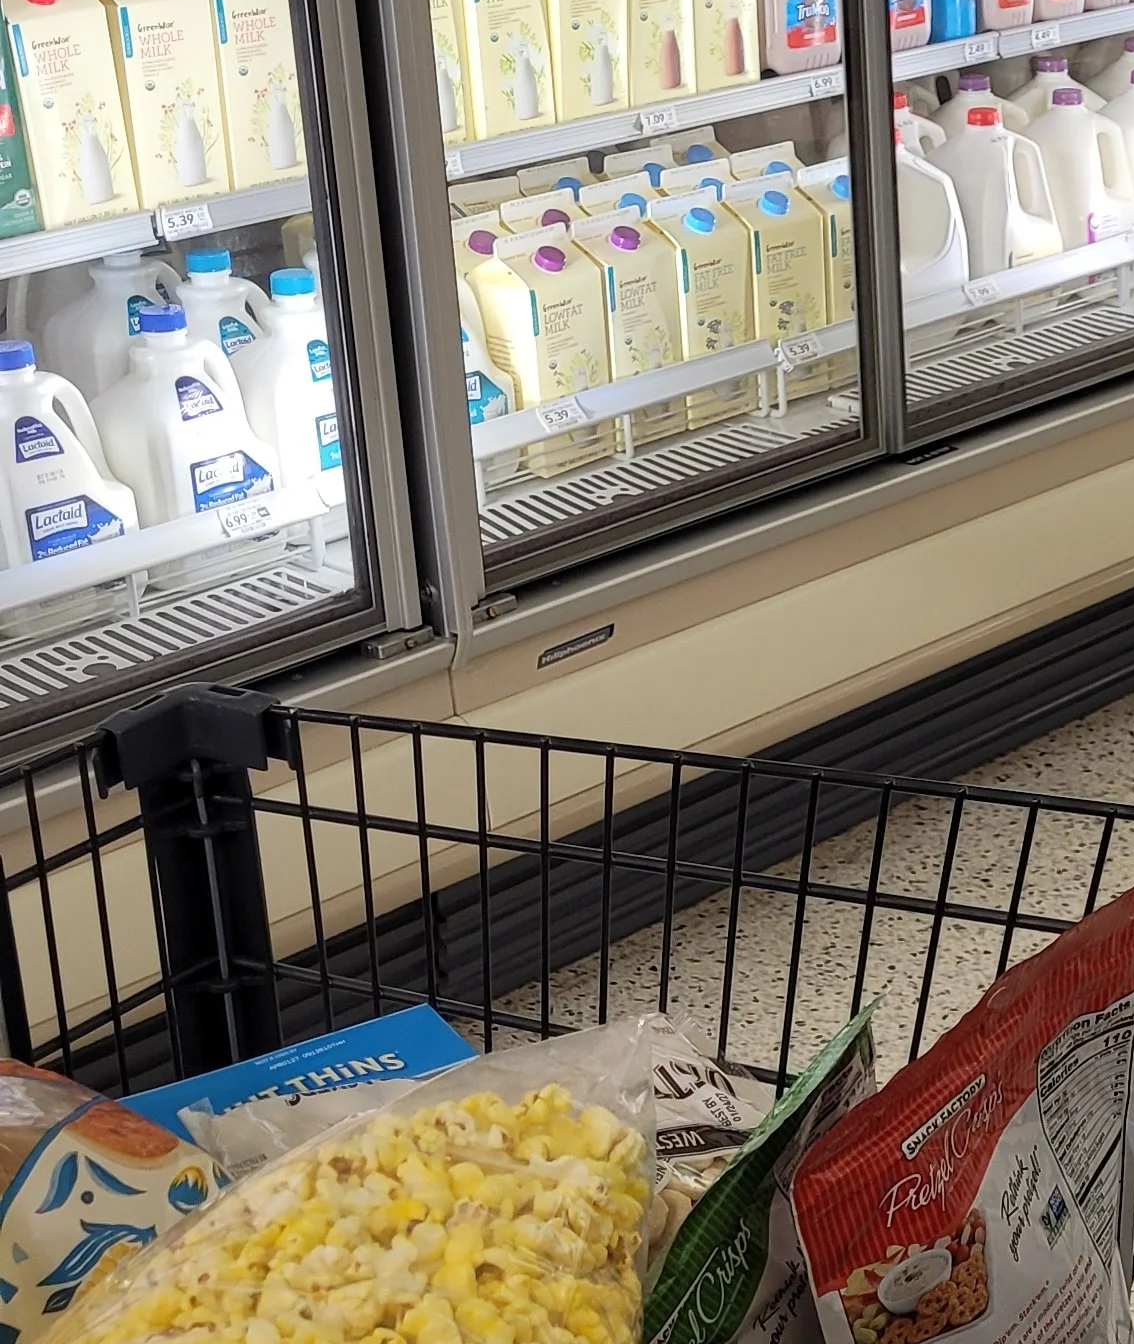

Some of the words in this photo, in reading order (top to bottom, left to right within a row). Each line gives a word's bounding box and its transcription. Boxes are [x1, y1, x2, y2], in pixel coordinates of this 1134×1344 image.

[233, 16, 277, 32] WHOLE
[139, 30, 184, 47] WHOLE
[235, 30, 266, 46] MILK
[33, 44, 81, 64] WHOLE
[140, 43, 173, 60] MILK
[968, 44, 985, 56] 2.49
[36, 60, 71, 77] MILK
[814, 77, 833, 89] 6.99
[645, 113, 665, 125] 7.09
[167, 213, 194, 230] 5.39
[620, 281, 658, 301] LOWFAT
[620, 298, 646, 312] MILK
[543, 304, 583, 324] LOWFAT
[544, 322, 570, 336] MILK
[224, 336, 252, 350] Lactaid
[789, 342, 810, 356] 5.39
[545, 409, 568, 424] 5.39
[23, 437, 55, 453] Lactaid
[35, 506, 83, 531] Lactaid
[225, 513, 249, 529] 6.99
[47, 541, 78, 557] Reduced
[78, 537, 90, 548] Fat
[1094, 999, 1131, 1025] Facts
[1040, 1057, 1079, 1100] Calories
[1102, 1029, 1132, 1048] 110
[702, 1096, 715, 1110] BY
[715, 1108, 733, 1128] BEST
[906, 1120, 939, 1156] SNACK
[940, 1078, 984, 1124] FACTORY
[879, 1129, 953, 1228] Pretzel
[951, 1078, 1004, 1158] Crisps
[1001, 1154, 1029, 1227] Rethink
[1009, 1214, 1025, 1263] your
[696, 1218, 751, 1324] Crisps
